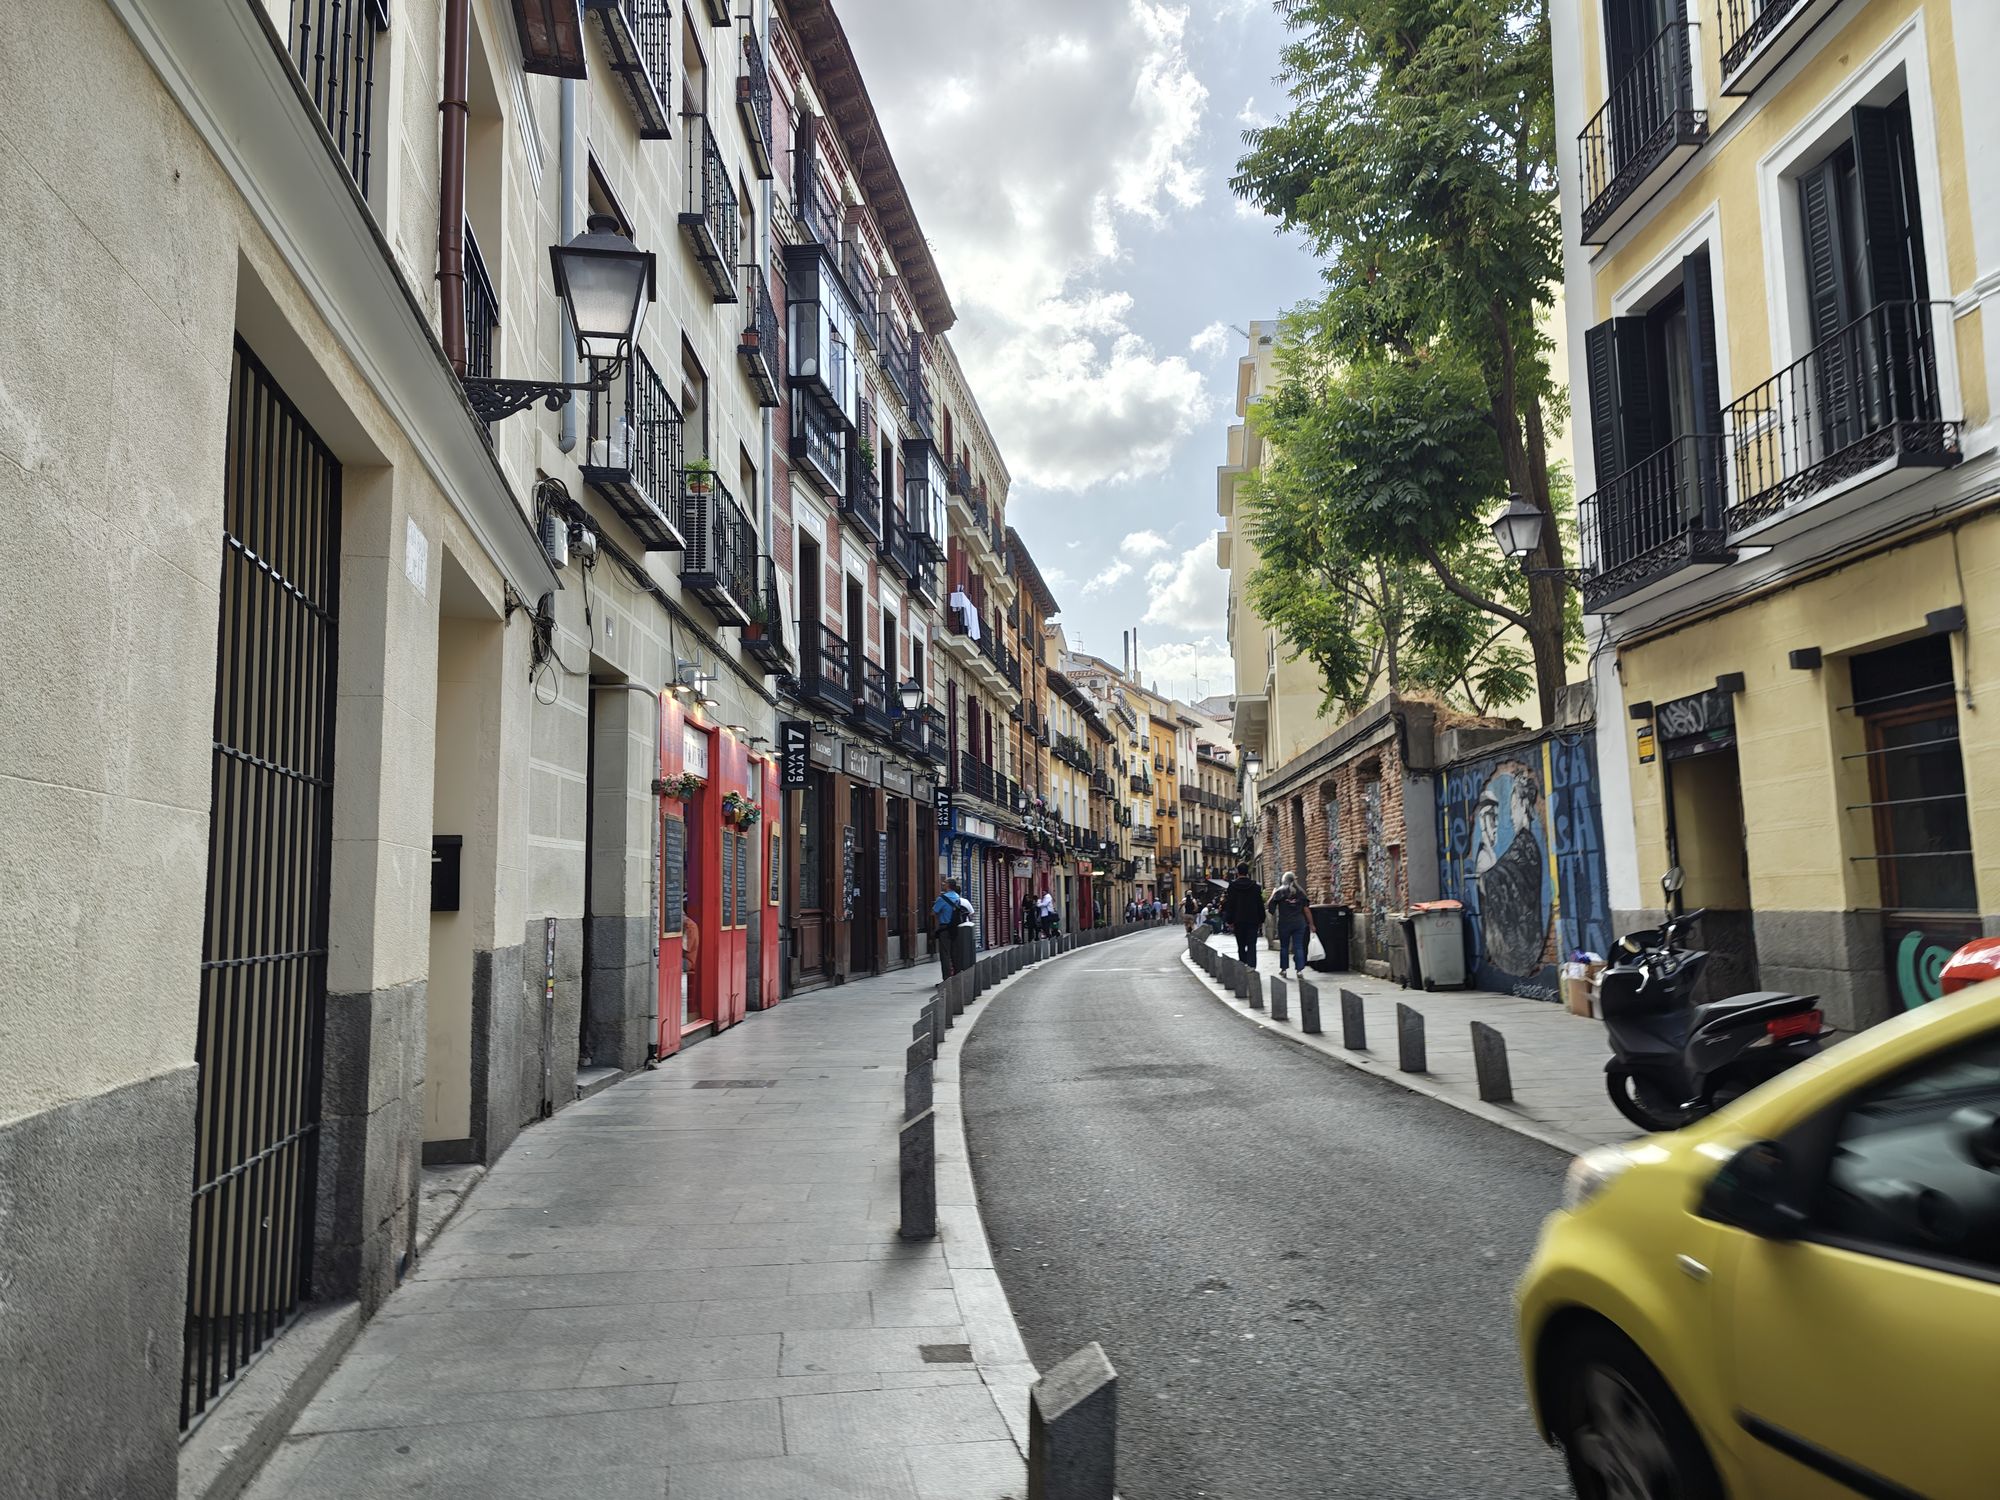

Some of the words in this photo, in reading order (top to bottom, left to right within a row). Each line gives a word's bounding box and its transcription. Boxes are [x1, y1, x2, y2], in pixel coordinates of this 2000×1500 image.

[788, 728, 805, 752] 17
[787, 754, 796, 783] CAVA
[796, 754, 805, 782] BAJA
[861, 754, 869, 777] 17
[937, 791, 949, 807] 17
